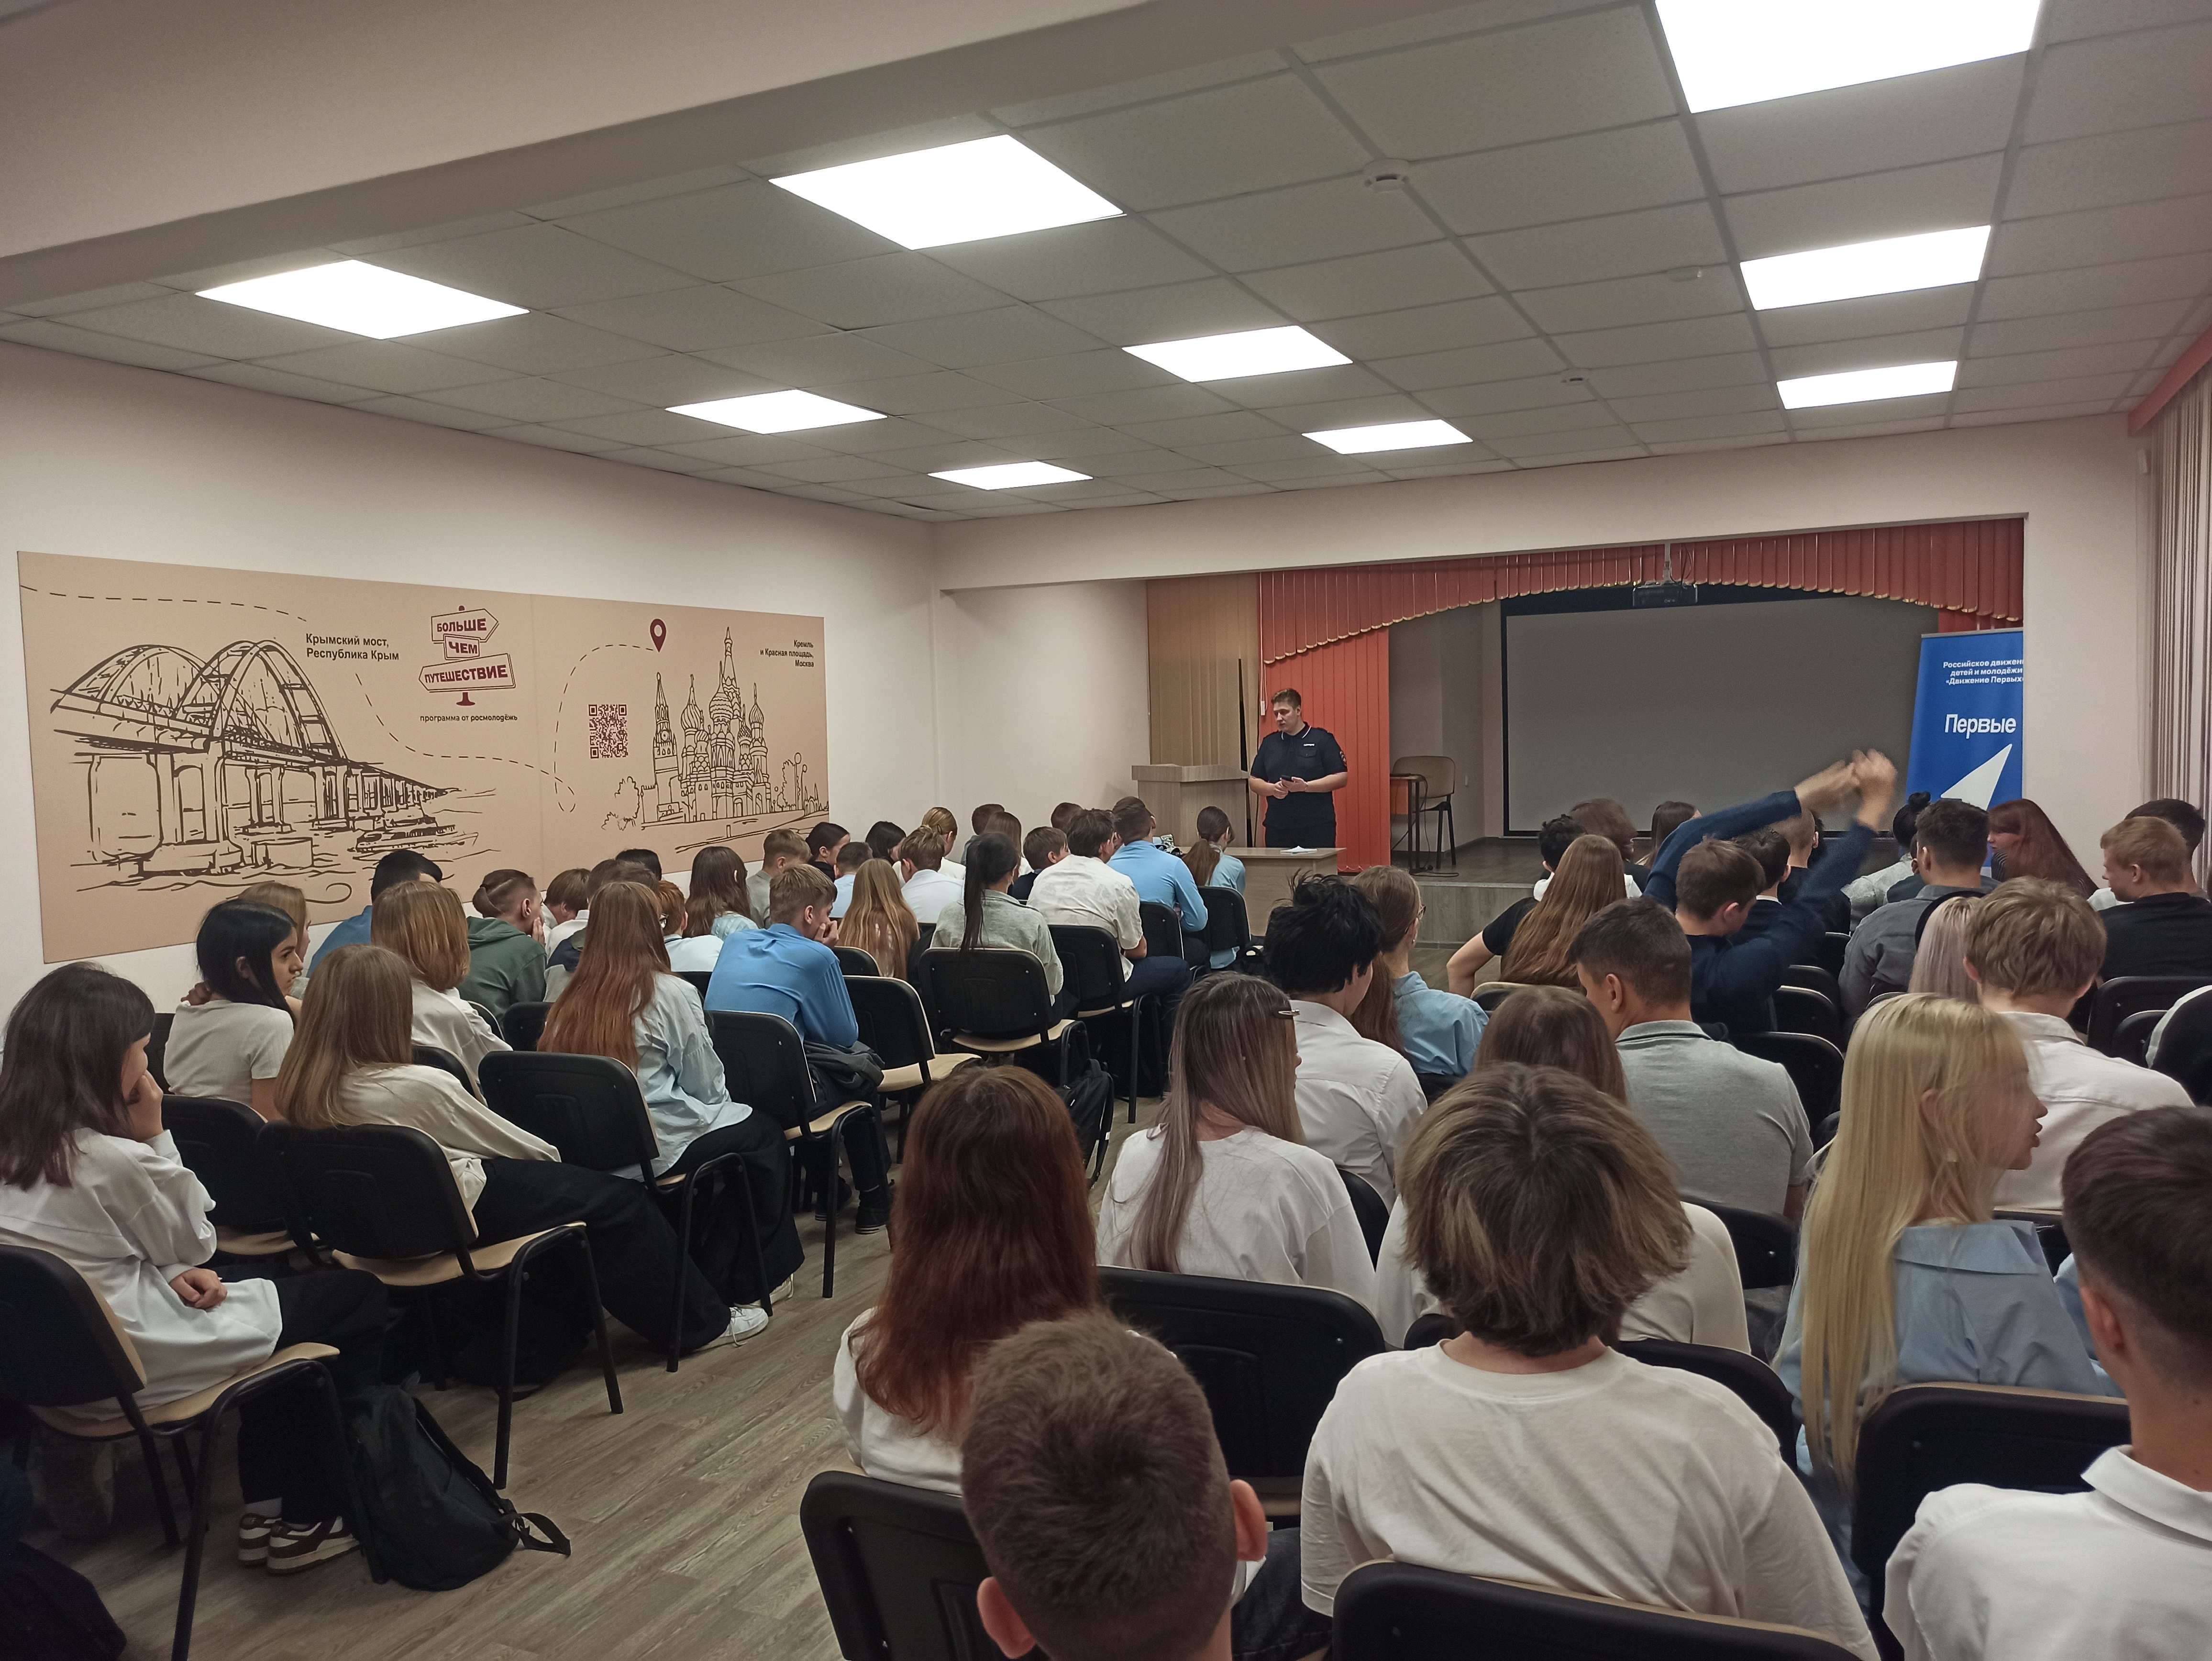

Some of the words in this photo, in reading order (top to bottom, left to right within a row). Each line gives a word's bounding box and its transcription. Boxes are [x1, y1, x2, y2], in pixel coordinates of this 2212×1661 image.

[436, 618, 487, 632] БОЛЬШЕ
[306, 633, 360, 646] Крымский
[363, 638, 389, 648] мост,
[794, 640, 814, 649] Кремль
[448, 641, 478, 654] ЧЕМ
[765, 648, 788, 657] Красная
[788, 651, 814, 659] площадь,
[307, 647, 368, 661] Республика
[371, 650, 399, 662] Крым
[795, 659, 814, 667] Москва
[1943, 660, 1990, 668] Российское
[424, 664, 508, 684] ПУТЕШЕСТВИЕ
[1950, 668, 1973, 677] детей
[1980, 667, 2023, 675] молодёжи
[1946, 677, 1990, 686] «Движение
[1945, 714, 2016, 739] Первые
